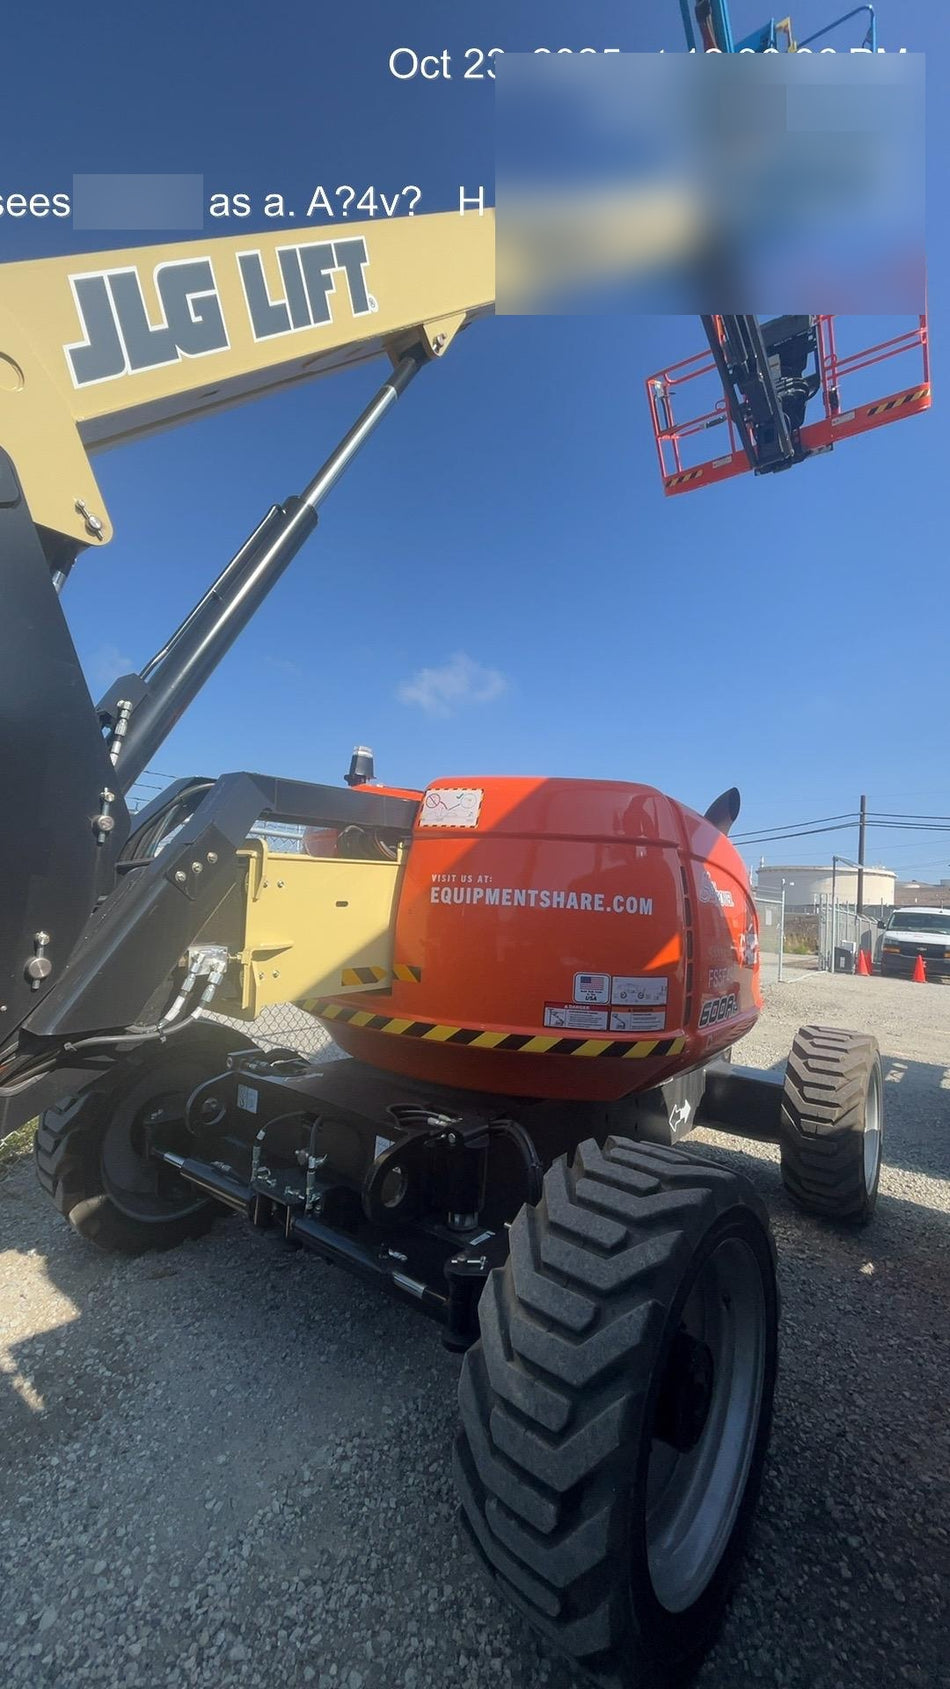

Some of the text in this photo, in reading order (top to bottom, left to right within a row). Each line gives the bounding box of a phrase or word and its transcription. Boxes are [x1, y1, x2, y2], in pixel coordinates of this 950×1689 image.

[63, 235, 370, 389] JLG LIFT
[431, 874, 493, 884] VISIT US AT:
[430, 886, 653, 916] EQUIPMENTSHARE.COM
